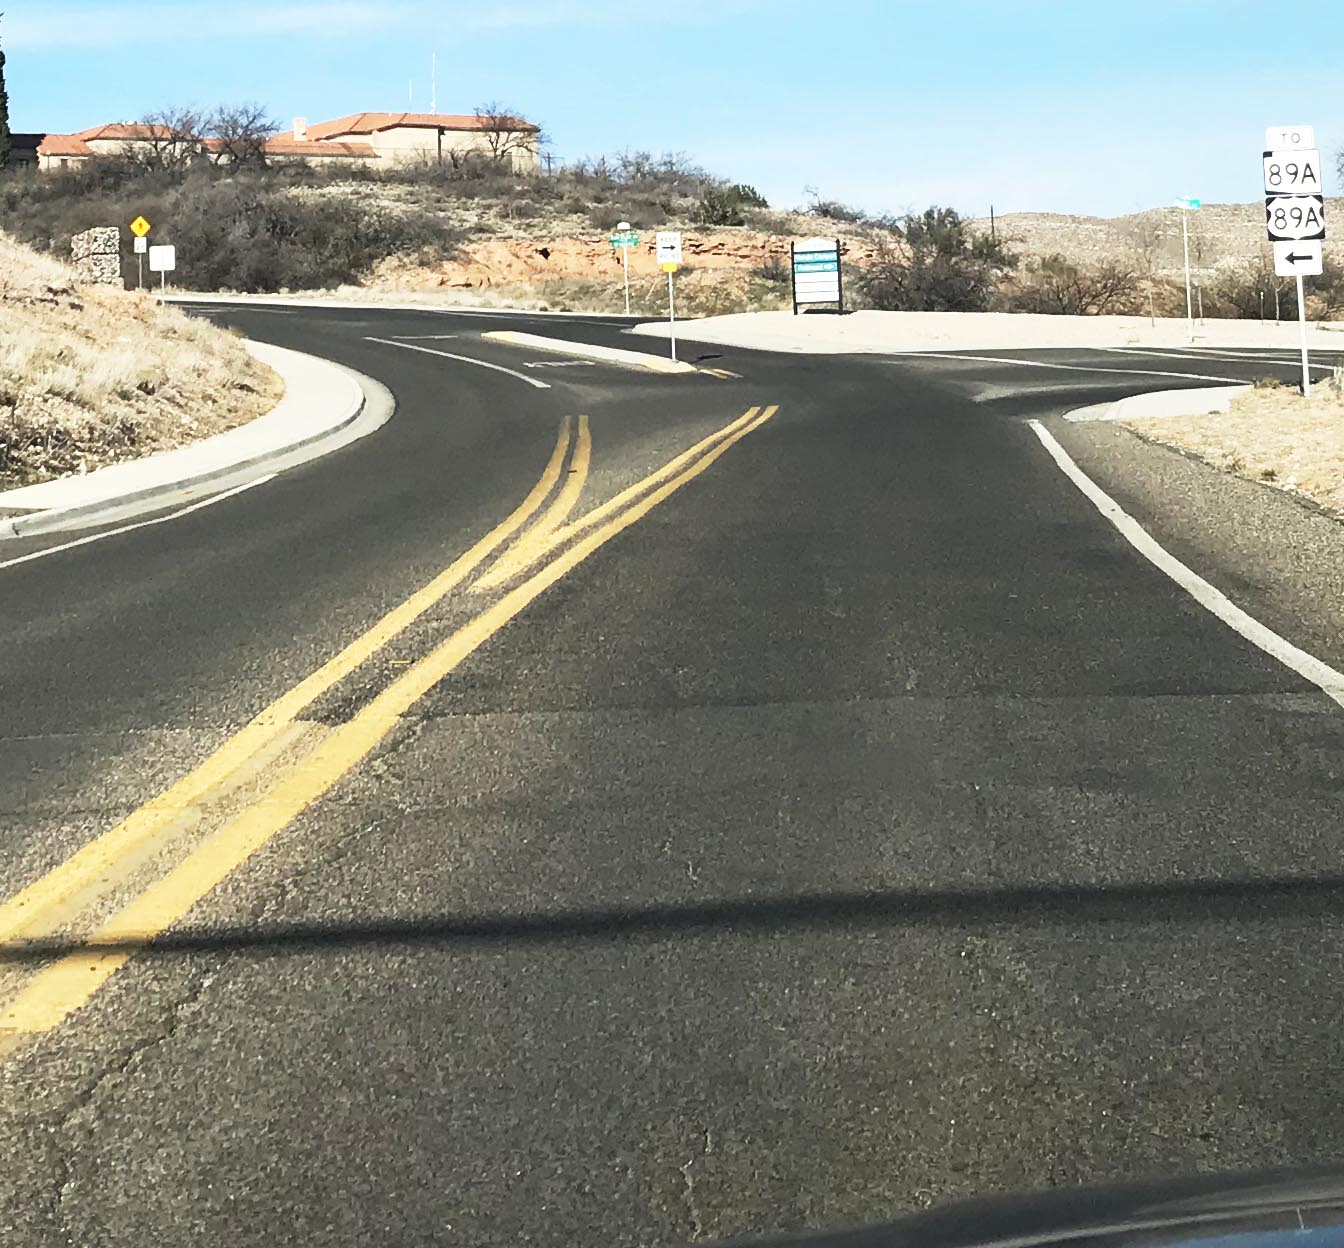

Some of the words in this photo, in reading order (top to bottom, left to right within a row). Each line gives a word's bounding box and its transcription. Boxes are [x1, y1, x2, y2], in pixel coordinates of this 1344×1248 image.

[1281, 132, 1301, 144] TO
[1269, 162, 1317, 186] 89A
[1274, 206, 1320, 230] 89A
